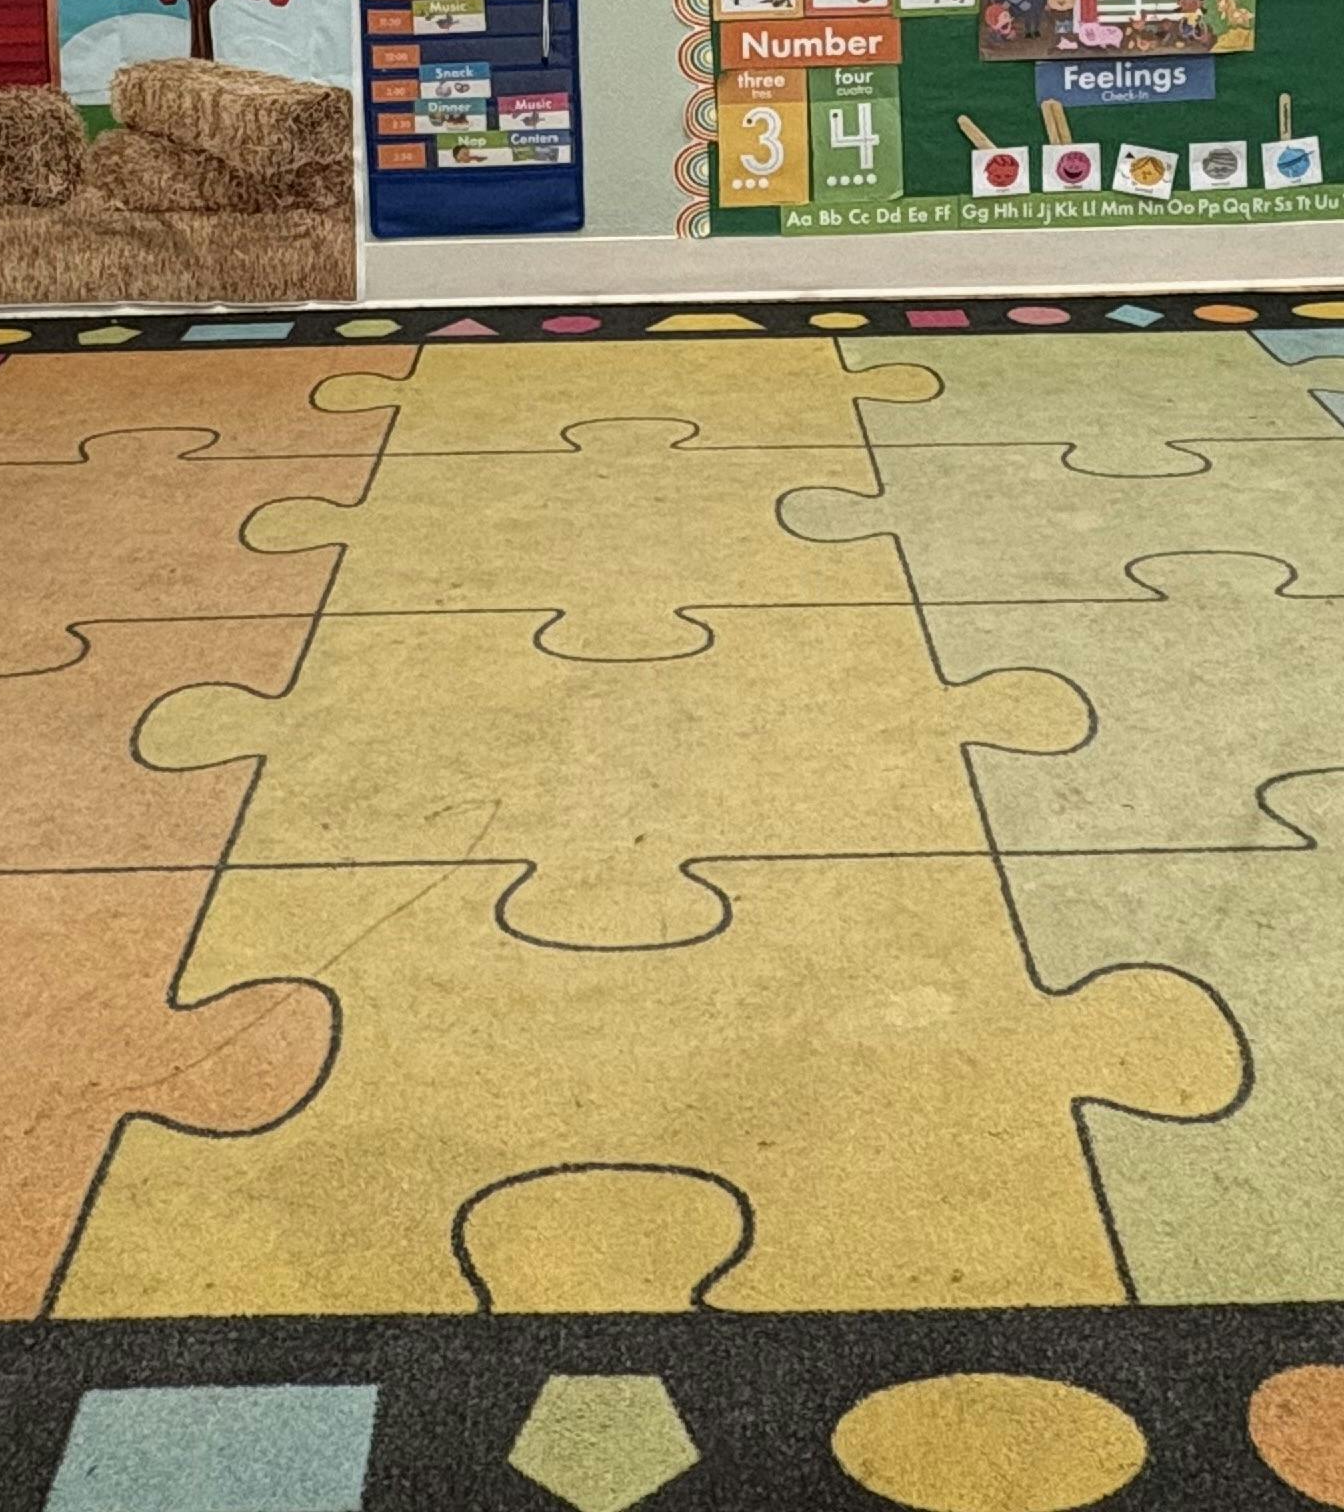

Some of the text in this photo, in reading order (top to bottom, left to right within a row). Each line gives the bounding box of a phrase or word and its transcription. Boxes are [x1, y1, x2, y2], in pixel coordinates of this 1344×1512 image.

[429, 0, 467, 14] Music
[741, 26, 884, 60] Number
[435, 66, 474, 79] Snack
[737, 70, 786, 89] three
[834, 68, 874, 86] four
[1063, 62, 1187, 92] Feelings
[836, 85, 873, 96] cuatro
[428, 101, 471, 113] Dinner
[514, 98, 553, 111] Music
[740, 105, 785, 176] 3
[829, 102, 880, 170] 4
[786, 211, 813, 227] Aa
[819, 209, 843, 226] Bb
[848, 209, 871, 225] Cc
[876, 207, 902, 224] Dd
[908, 206, 929, 223] Ee
[934, 204, 952, 221] Ff
[962, 204, 990, 224] Gg
[994, 202, 1018, 219] Hh
[1022, 202, 1033, 219] Ii
[1036, 203, 1052, 225] Jj
[1055, 202, 1078, 218] Kk
[1083, 200, 1097, 217] Ll
[1100, 200, 1134, 217] Mm
[1138, 200, 1164, 217] Nn
[1168, 199, 1196, 216] Oo
[1198, 198, 1221, 220] Pp
[1223, 198, 1251, 221] Qq
[1253, 197, 1271, 213] Rr
[1274, 196, 1293, 212] Ss
[1296, 195, 1312, 211] Tt
[1314, 194, 1339, 211] Uu
